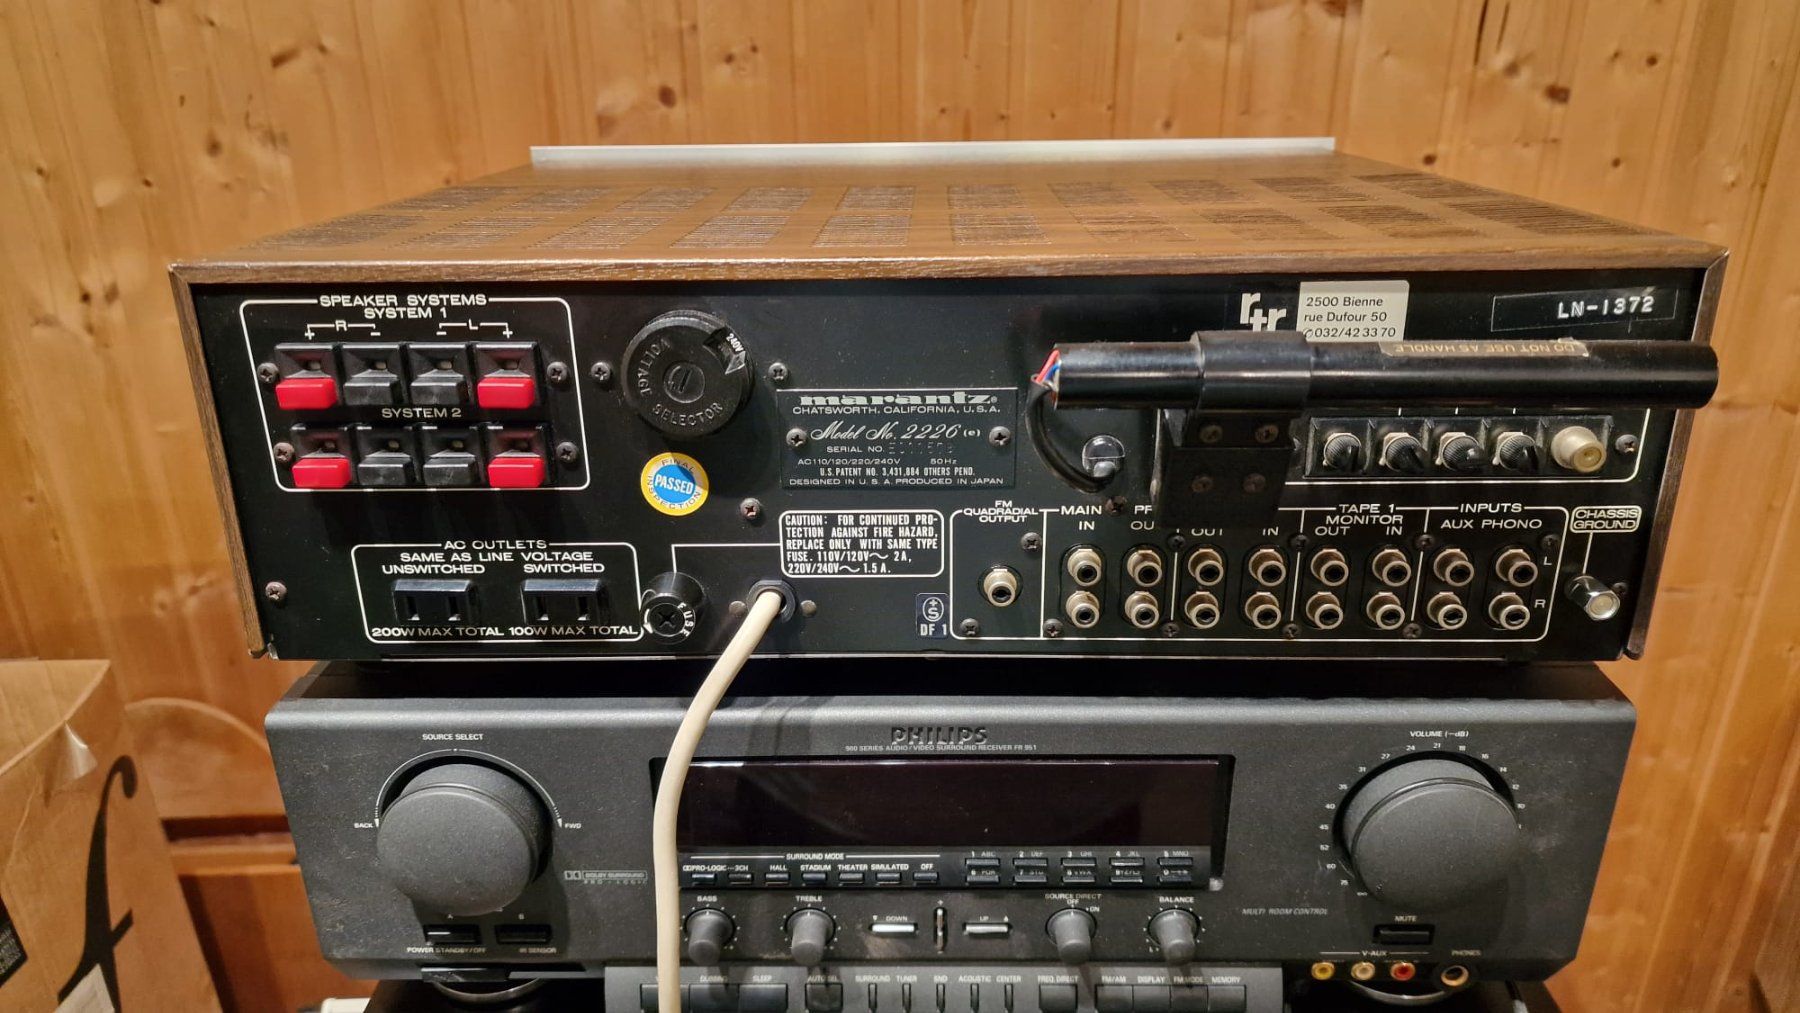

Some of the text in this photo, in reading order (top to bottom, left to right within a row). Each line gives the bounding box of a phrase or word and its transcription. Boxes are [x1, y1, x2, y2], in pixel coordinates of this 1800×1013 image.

[319, 293, 487, 308] SPEAKER SYSTEMS
[1305, 296, 1384, 307] 2500 Bienne
[363, 306, 448, 319] SYSTEM 1
[1556, 294, 1656, 320] LN-1372
[1303, 311, 1388, 323] rue Dufour 50
[335, 319, 347, 332] R
[468, 319, 479, 331] L
[725, 332, 745, 353] 240V
[1394, 343, 1576, 353] DO NOT USE AS HANDLE
[799, 391, 992, 406] marantz
[381, 407, 462, 419] SYSTEM 2
[652, 401, 725, 427] SELECTOR
[810, 420, 867, 440] Model
[865, 420, 899, 440] No.
[900, 423, 962, 440] 2226
[826, 445, 863, 453] SERIAL
[661, 457, 696, 472] FINAL
[865, 467, 879, 477] NO.
[923, 466, 951, 476] OTHERS
[954, 466, 976, 476] PEND.
[654, 473, 695, 496] PASSED
[789, 478, 841, 486] DESIGNED
[970, 477, 1004, 485] JAPAN
[994, 500, 1013, 508] FM
[1339, 503, 1395, 514] TAPE 1
[1460, 502, 1523, 513] INPUTS
[963, 507, 1039, 516] QUADRADIAL
[1060, 505, 1103, 516] MAIN
[1575, 508, 1640, 519] CHASSIS
[785, 514, 938, 526] CAUTION: FOR CONTINUED PRO-
[978, 515, 1028, 523] OUTPUT
[1325, 515, 1403, 525] MONITOR
[1440, 519, 1474, 530] AUX
[1481, 519, 1543, 530] PHONO
[1573, 519, 1638, 530] GROUND
[1078, 520, 1095, 531] IN
[1315, 525, 1351, 536] OUT
[1385, 525, 1403, 536] IN
[785, 527, 824, 538] TECTION
[831, 527, 869, 538] AGAINST
[873, 527, 894, 538] FIRE
[444, 539, 547, 550] AC OUTLETS
[786, 538, 938, 550] REPLACE ONLY WITH SAME TYPE
[400, 551, 594, 562] SAME AS LINE VOLTAGE
[786, 551, 813, 562] FUSE.
[1543, 556, 1553, 566] L
[382, 564, 486, 575] UNSWITCHED
[523, 562, 605, 574] SWITCHED
[1534, 598, 1546, 609] R
[371, 626, 505, 638] 200W MAX TOTAL
[507, 625, 638, 637] 100W MAX TOTAL
[919, 623, 948, 637] DF 1
[422, 732, 484, 741] SOURCE SELECT
[890, 726, 989, 746] PHILIPS
[786, 852, 844, 861] SURROUND MODE
[1159, 896, 1195, 904] BALANCE
[406, 946, 434, 954] POWER
[855, 975, 891, 983] SURROUND
[896, 975, 918, 983] TUNER
[958, 975, 992, 983] ACOUSTIC
[996, 975, 1022, 983] CENTER
[1137, 975, 1165, 983] DISPLAY
[1210, 975, 1241, 983] MEMORY
